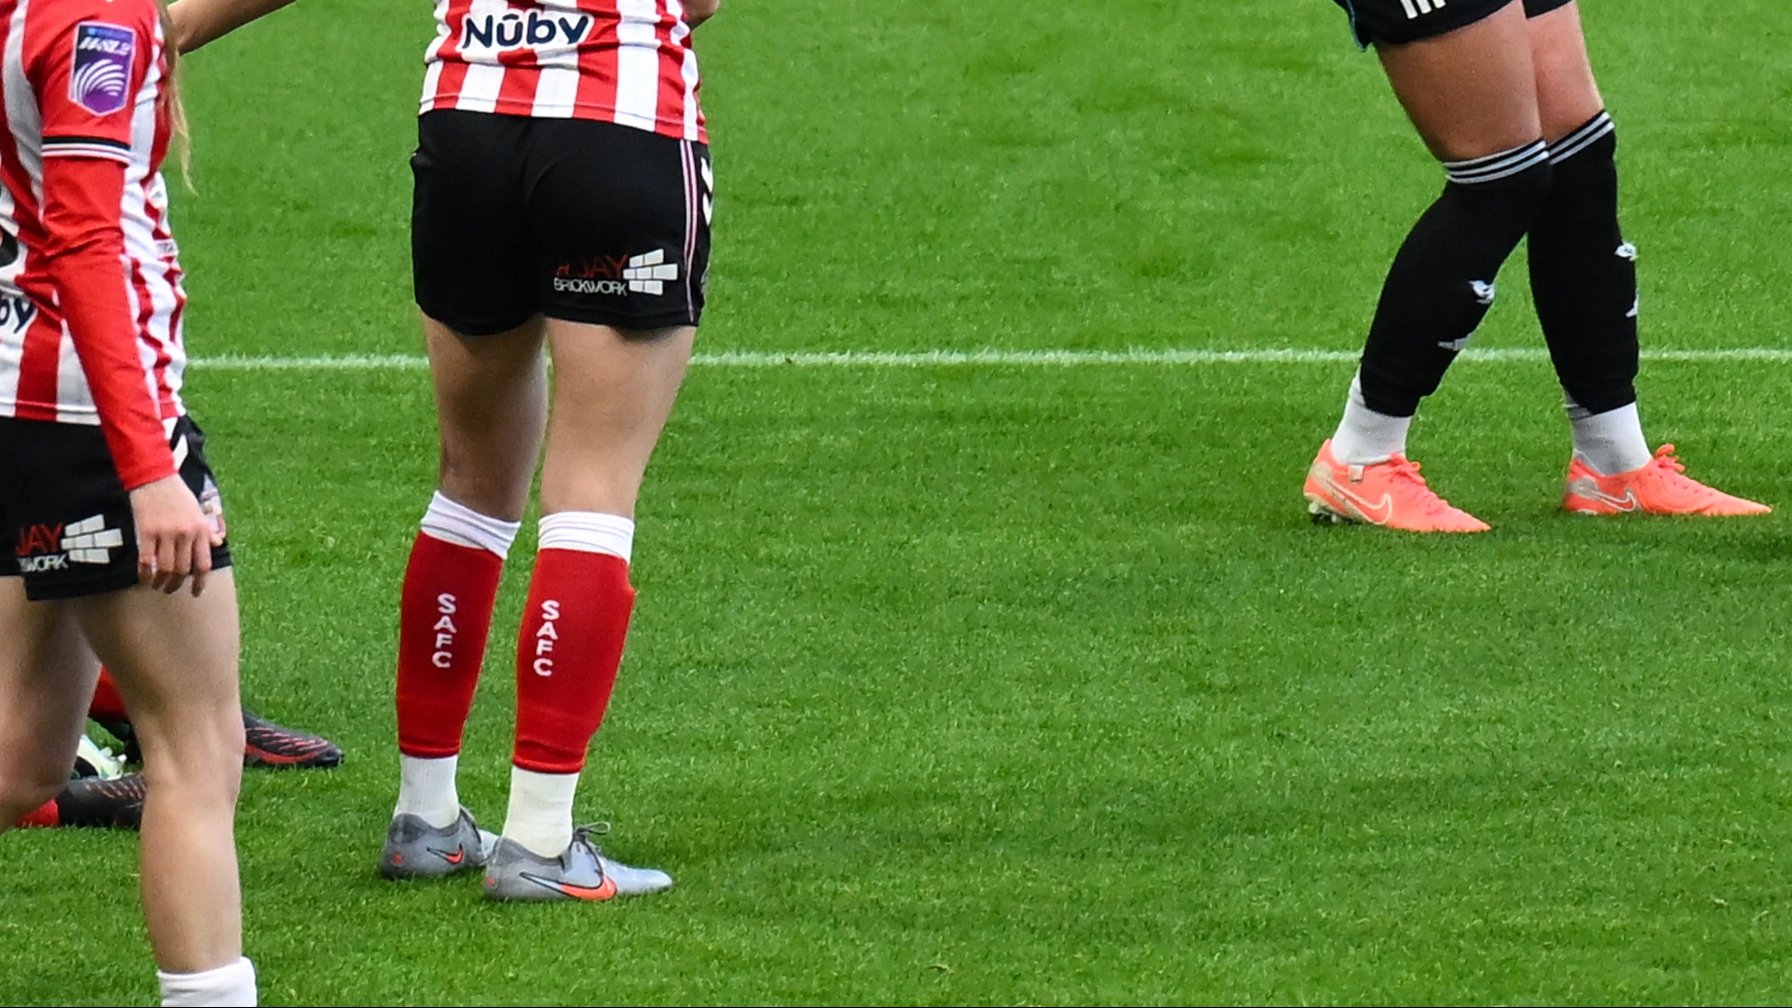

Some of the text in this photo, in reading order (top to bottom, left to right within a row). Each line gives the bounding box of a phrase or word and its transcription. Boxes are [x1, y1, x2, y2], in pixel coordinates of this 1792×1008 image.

[553, 277, 628, 297] BRICKWORK
[16, 523, 64, 556] JAY
[432, 593, 458, 668] SAFC
[533, 600, 560, 677] SAFC
